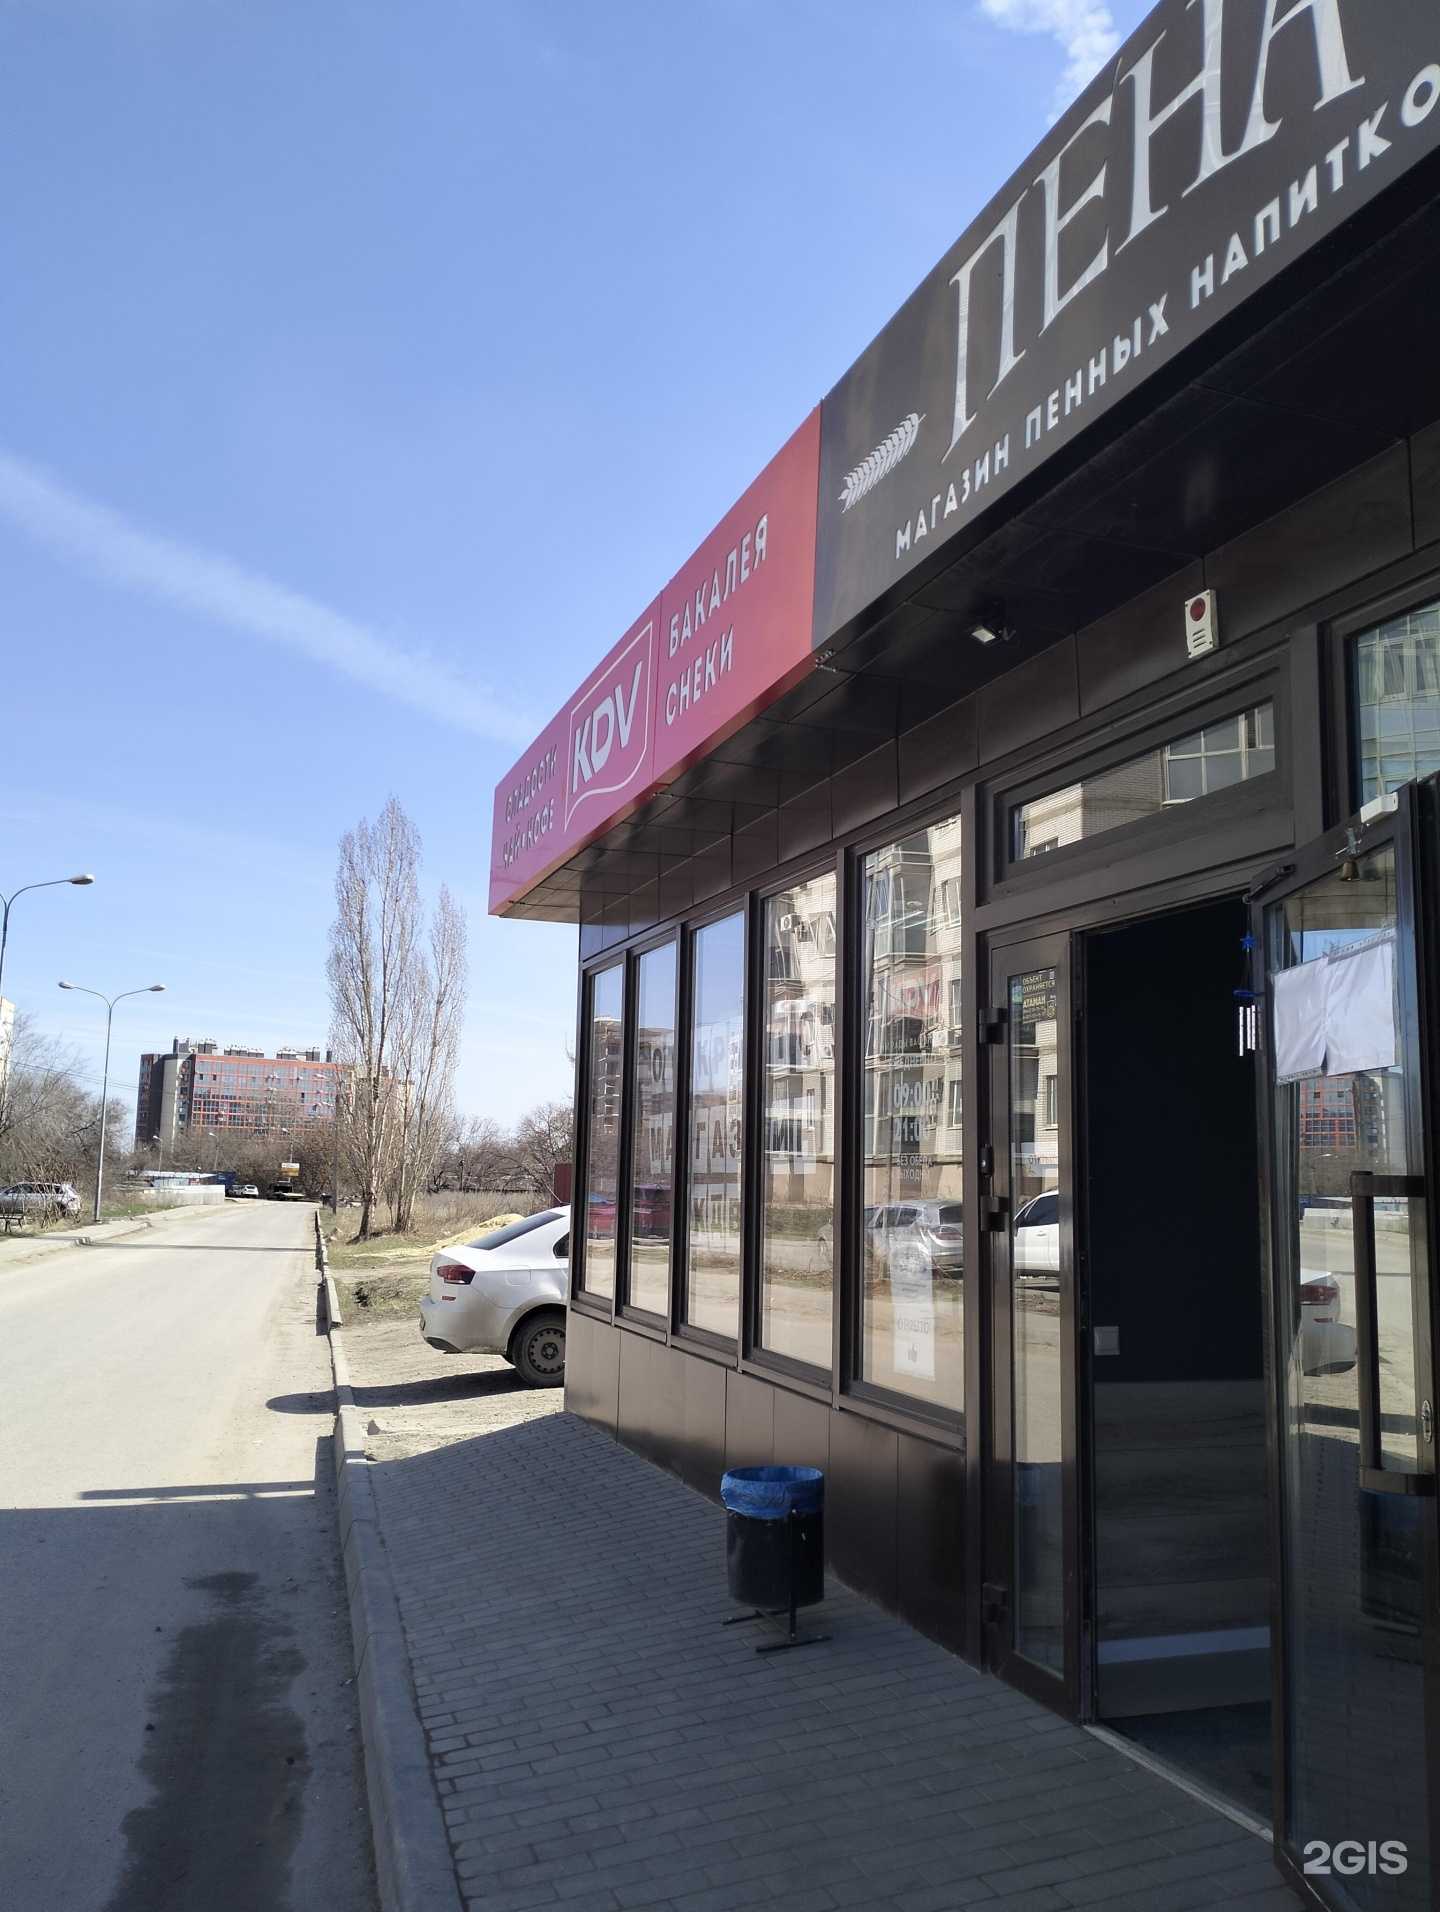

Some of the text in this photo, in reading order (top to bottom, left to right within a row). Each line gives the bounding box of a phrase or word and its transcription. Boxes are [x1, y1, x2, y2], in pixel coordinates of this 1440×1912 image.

[895, 63, 1440, 559] МАГАЗИН ПЕННЫХ НАПИТКО
[668, 513, 768, 658] БАКАЛЕЯ
[572, 661, 643, 793] KDV
[665, 624, 734, 727] СНЕКИ
[505, 743, 558, 824] СЛАДОСТИ
[527, 797, 555, 850] КОФЕ
